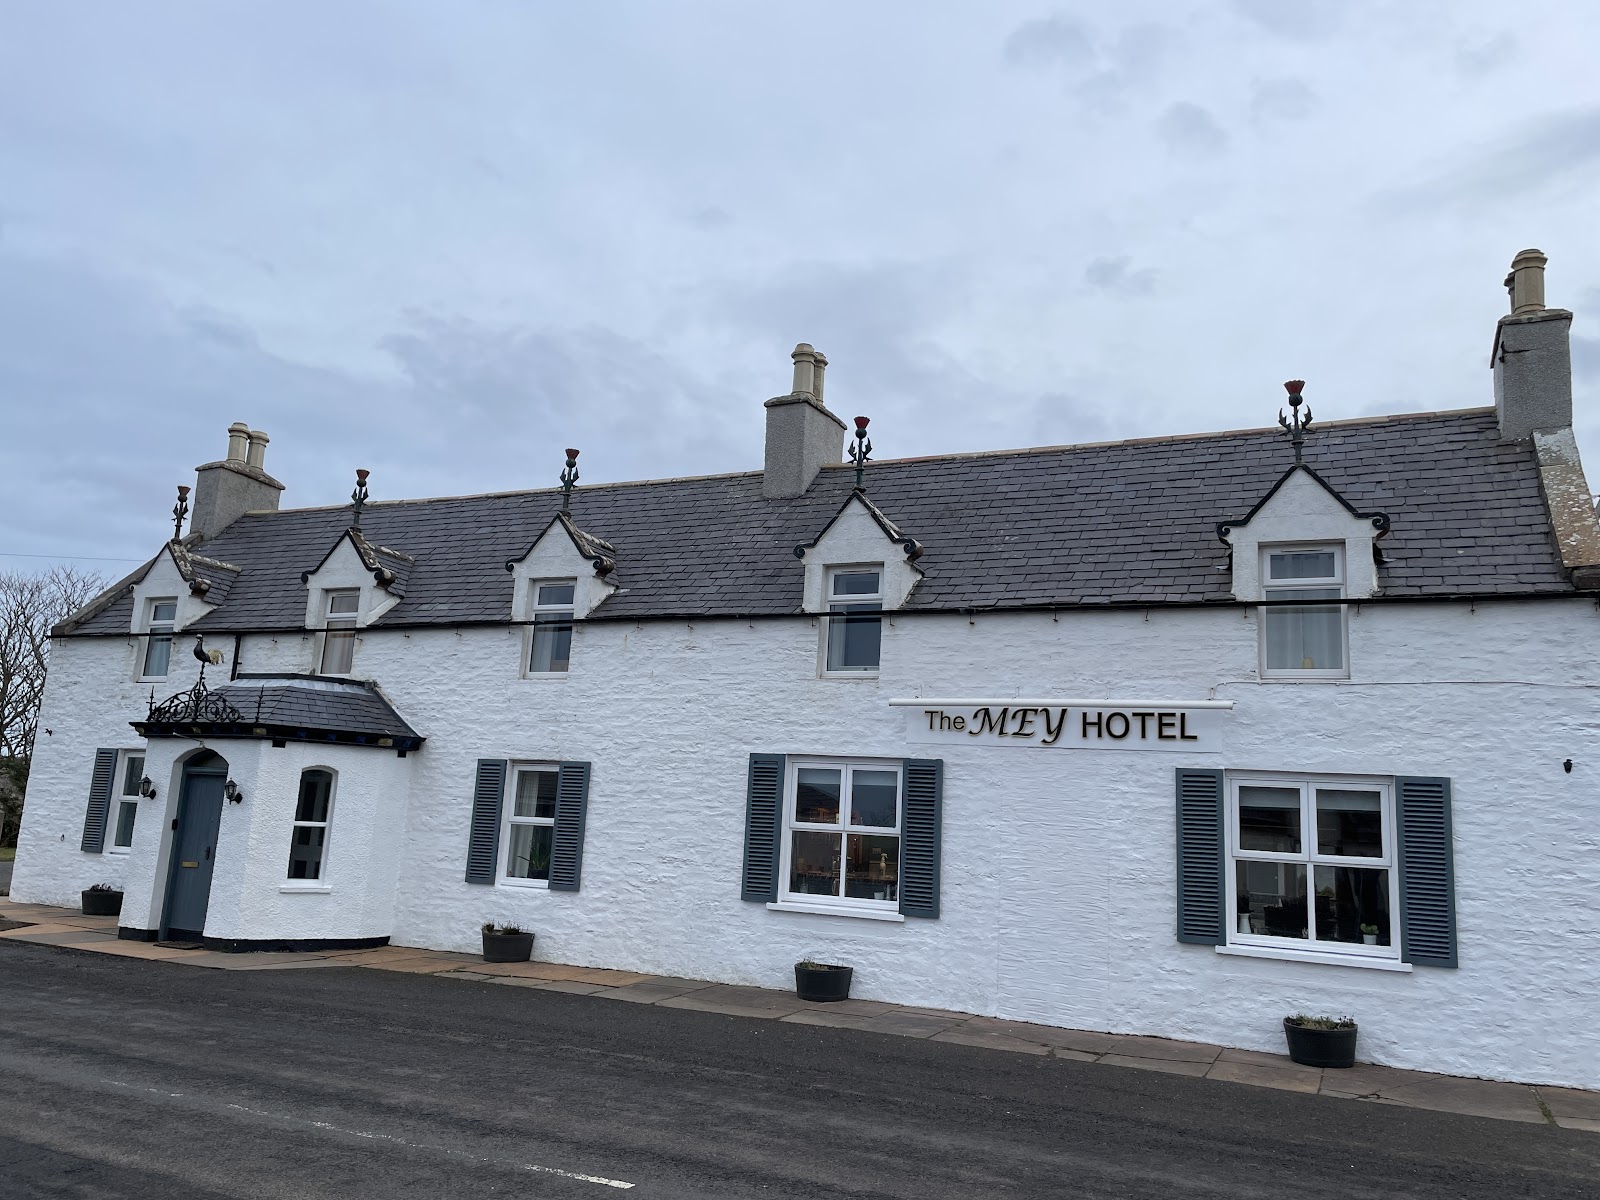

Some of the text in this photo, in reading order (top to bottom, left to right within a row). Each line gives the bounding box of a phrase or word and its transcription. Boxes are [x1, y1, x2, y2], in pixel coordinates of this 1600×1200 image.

[924, 707, 1198, 745] The MEY HOTEL
